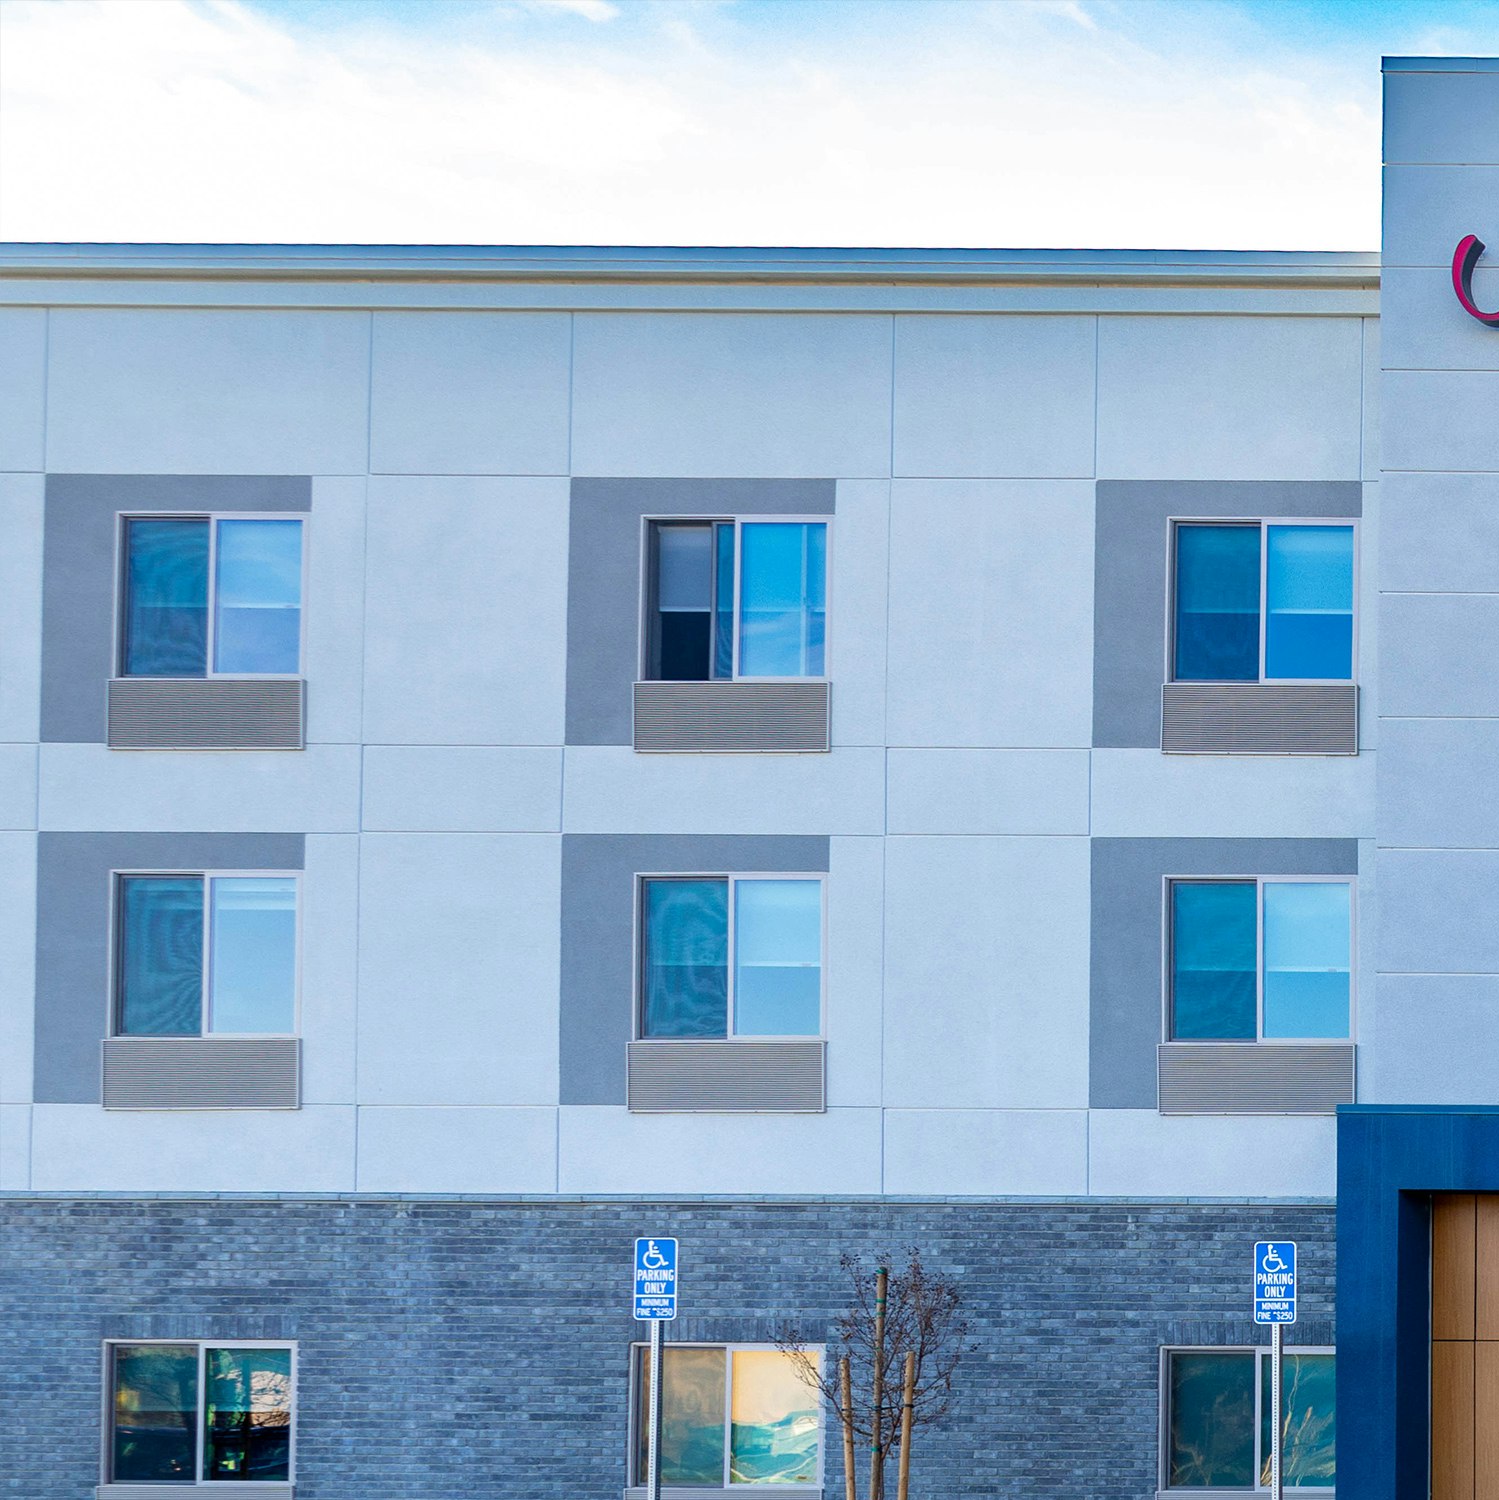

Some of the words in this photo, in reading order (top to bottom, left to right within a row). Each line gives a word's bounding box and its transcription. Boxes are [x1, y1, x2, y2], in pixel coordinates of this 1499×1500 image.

[637, 1269, 675, 1281] PARKING
[1257, 1273, 1293, 1285] PARKING
[643, 1282, 667, 1294] ONLY
[1264, 1285, 1286, 1298] ONLY
[641, 1298, 669, 1306] MINIMUM
[1261, 1302, 1289, 1310] MINIMUM
[636, 1308, 651, 1316] FINE
[1257, 1311, 1271, 1320] FINE
